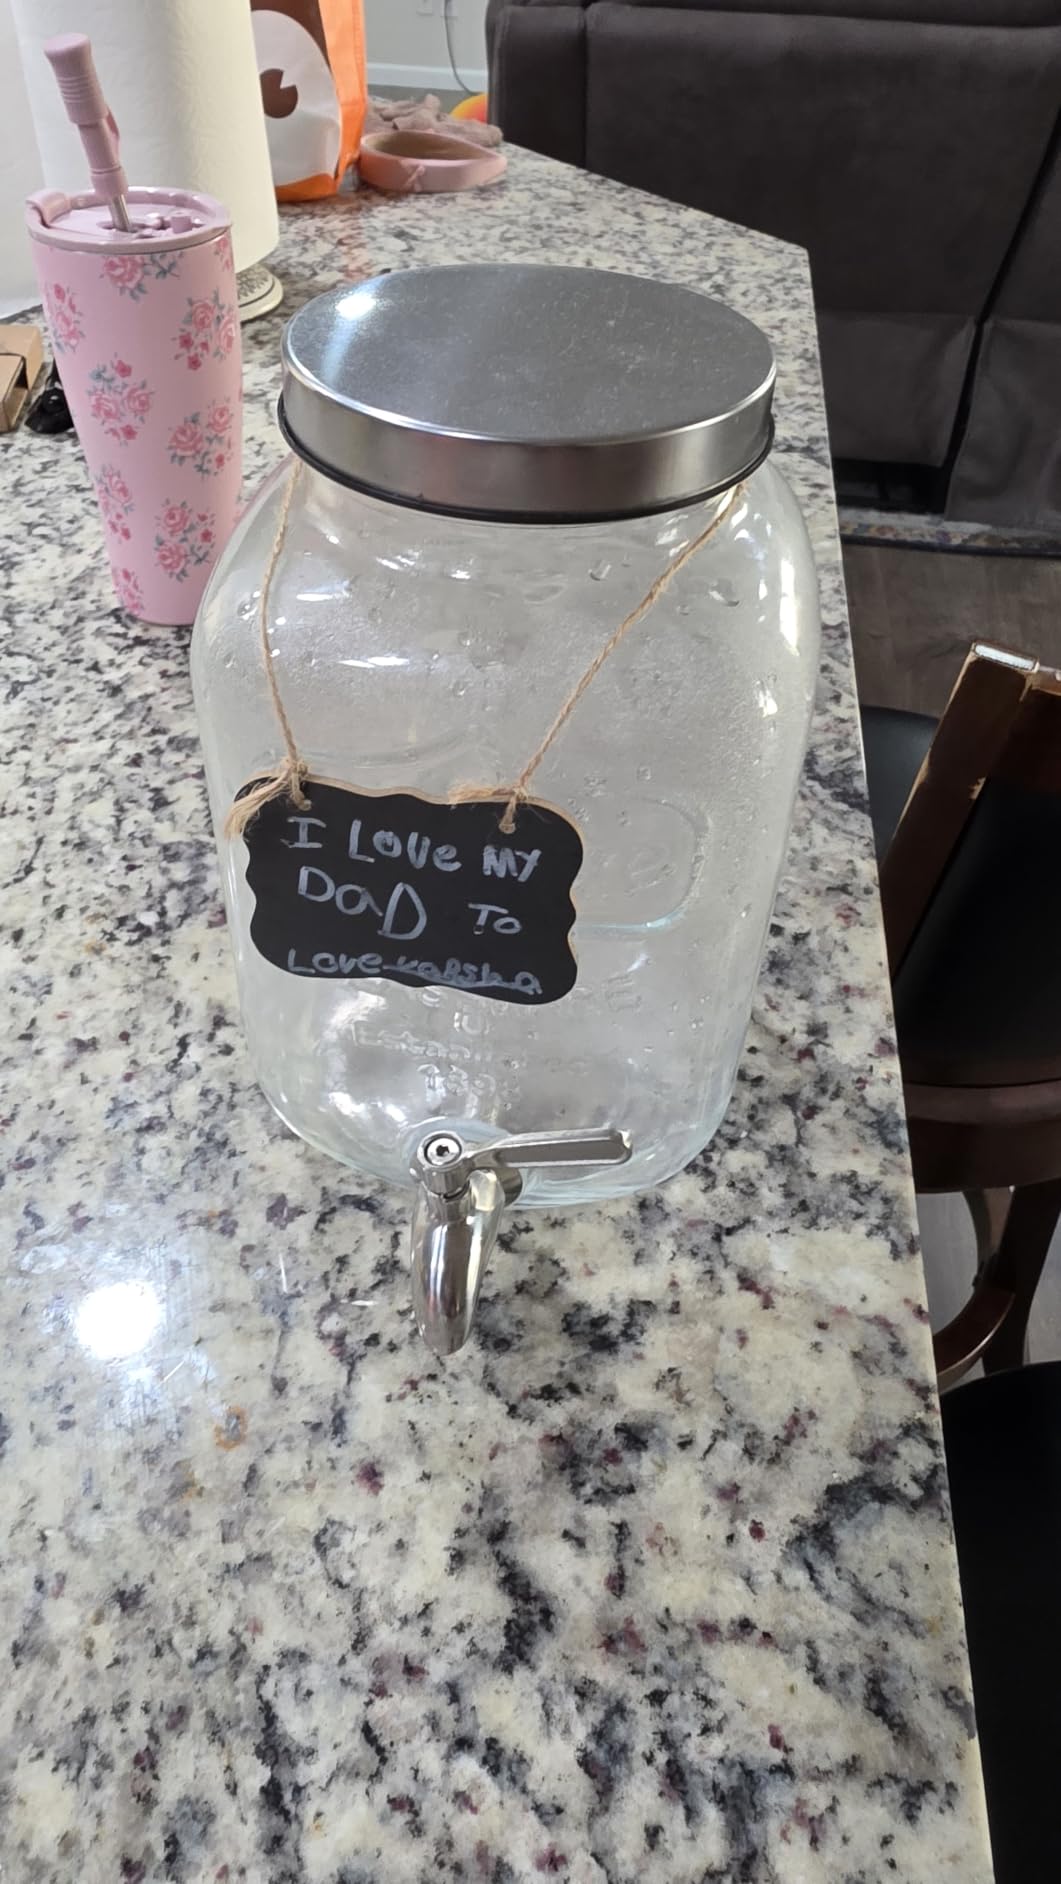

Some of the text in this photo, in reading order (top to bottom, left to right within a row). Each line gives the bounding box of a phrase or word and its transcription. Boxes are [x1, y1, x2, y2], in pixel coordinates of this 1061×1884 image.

[281, 816, 327, 849] I
[483, 844, 542, 882] MY
[297, 866, 522, 940] DaD To
[287, 948, 383, 974] Love
